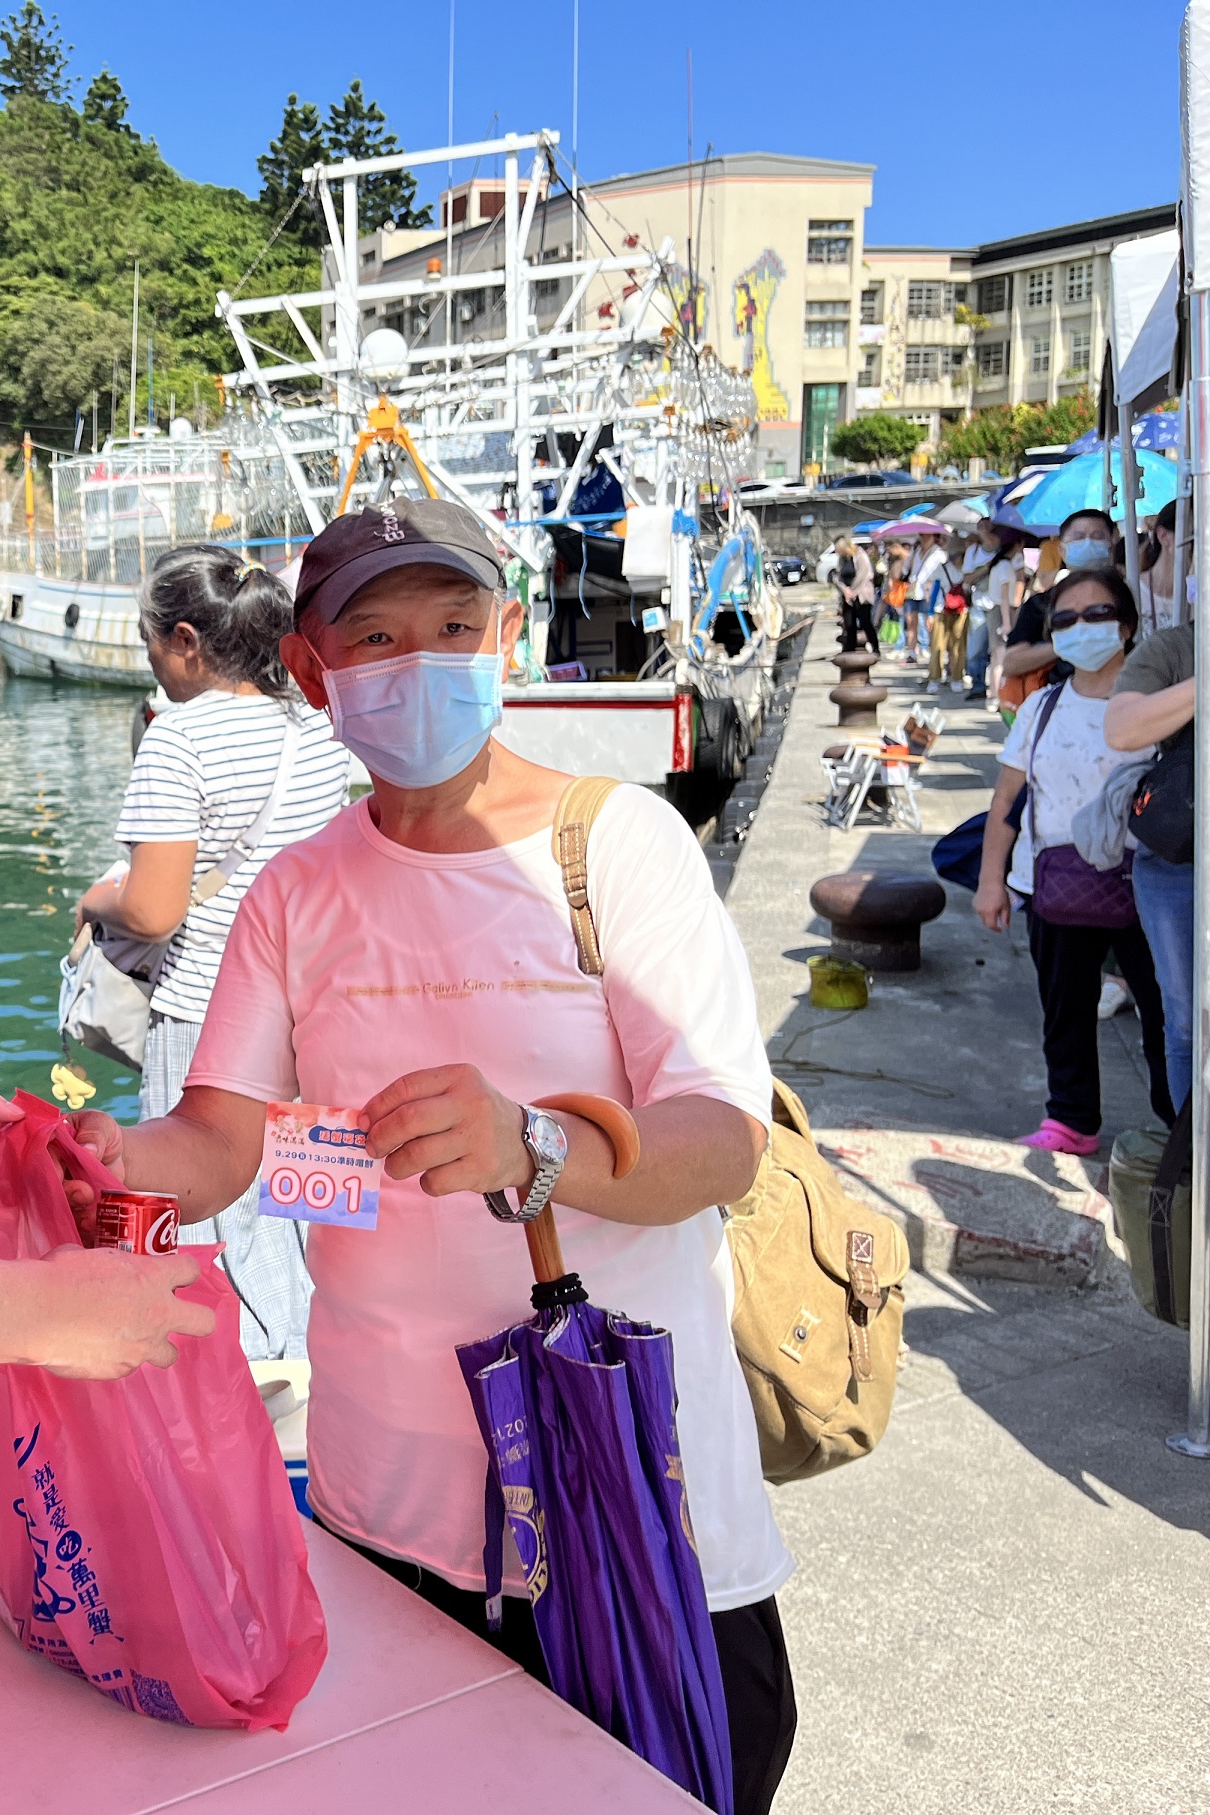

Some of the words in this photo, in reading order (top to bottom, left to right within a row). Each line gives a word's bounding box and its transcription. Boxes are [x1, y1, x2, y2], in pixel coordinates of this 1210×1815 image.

[269, 1167, 362, 1214] 001
[32, 1461, 114, 1636] 就是愛吃萬里蟹
